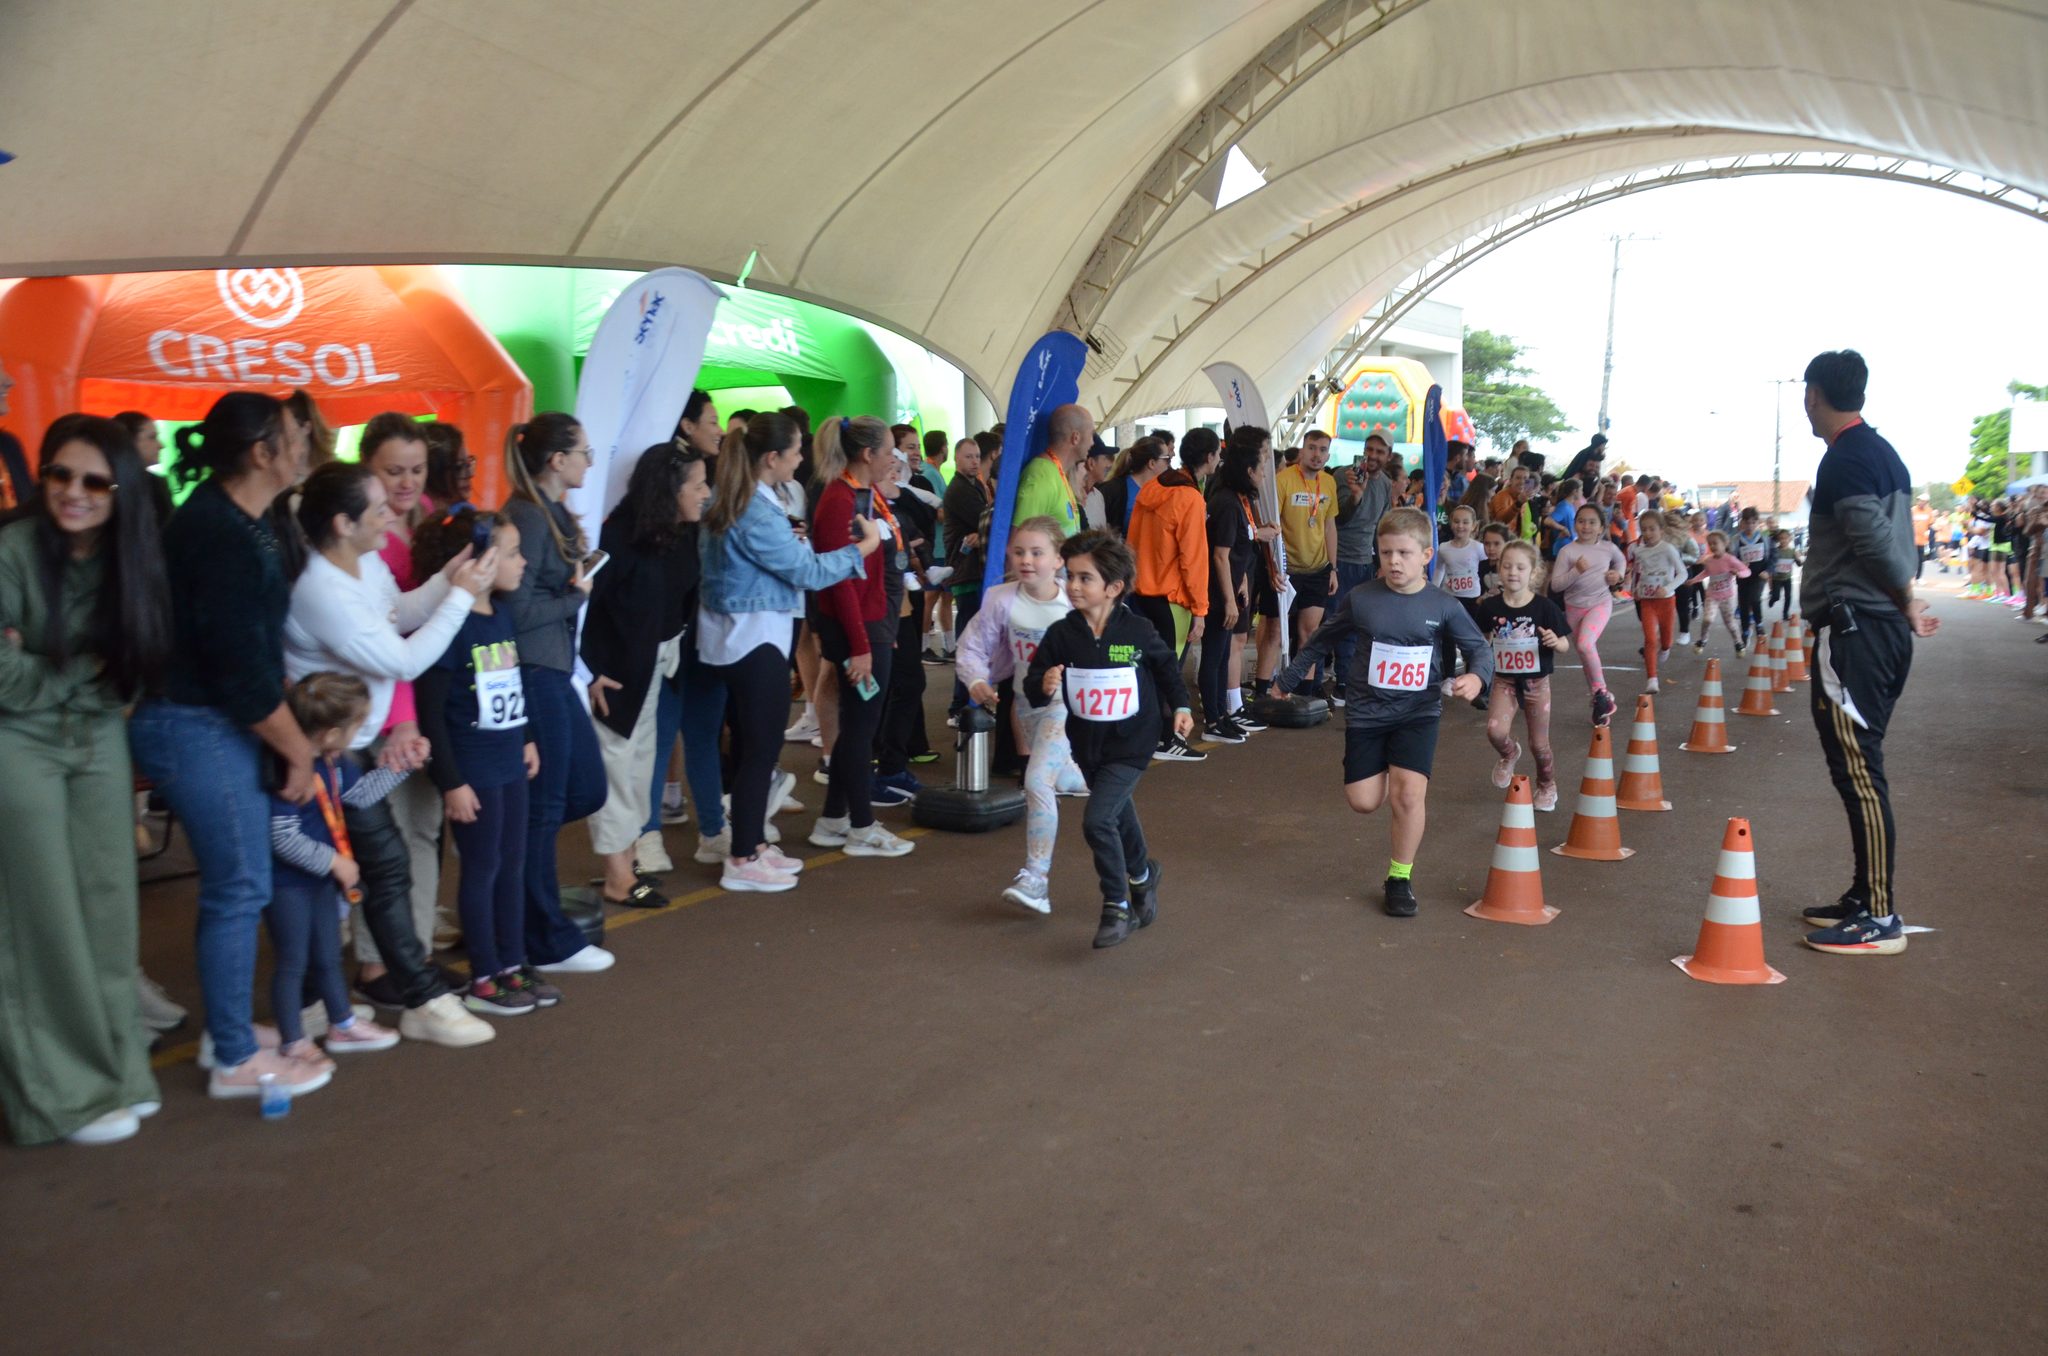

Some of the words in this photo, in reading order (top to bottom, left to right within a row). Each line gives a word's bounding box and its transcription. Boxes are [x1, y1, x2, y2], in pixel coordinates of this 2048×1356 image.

[146, 329, 400, 386] CRESOL
[1446, 576, 1473, 591] 1366
[1109, 645, 1135, 654] ADVEN
[1497, 650, 1536, 670] 1269
[1376, 660, 1426, 687] 1265
[1075, 687, 1133, 716] 1277
